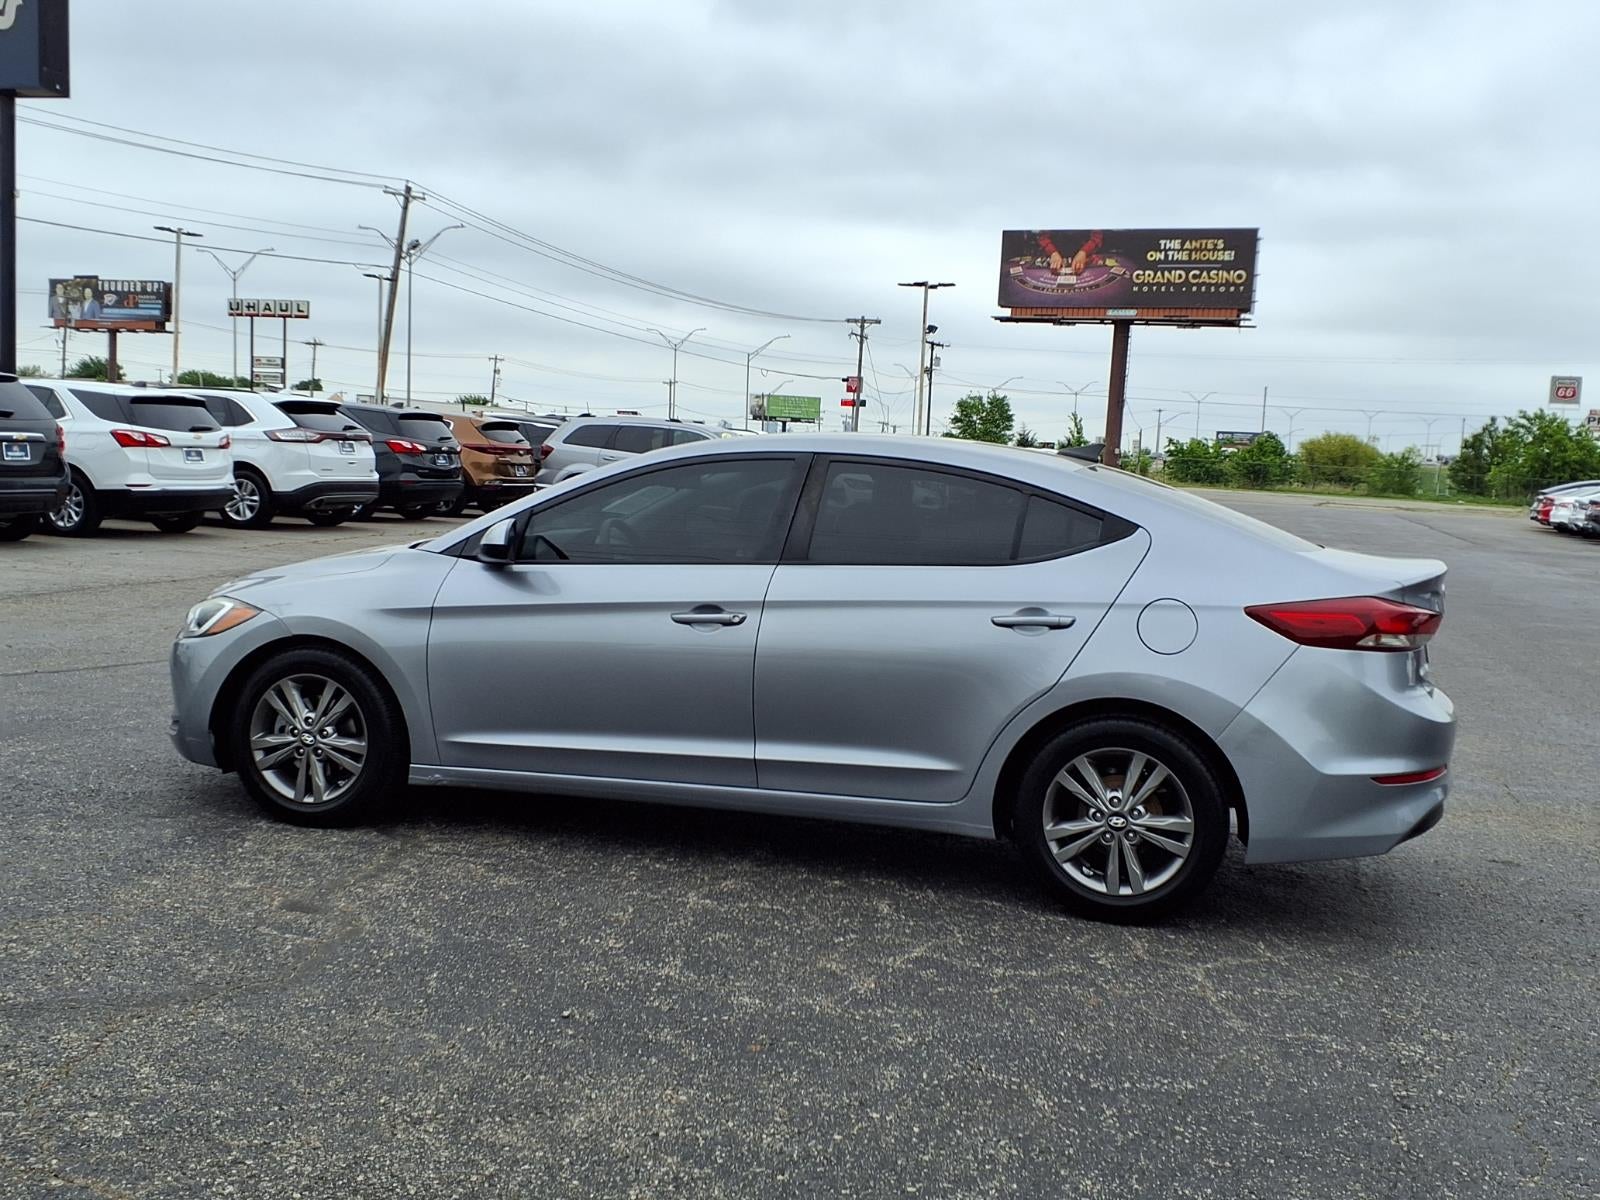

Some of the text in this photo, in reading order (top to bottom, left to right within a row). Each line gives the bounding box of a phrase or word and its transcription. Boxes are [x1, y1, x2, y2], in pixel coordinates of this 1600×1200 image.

[1159, 239, 1224, 249] THE ANTE'S
[1146, 250, 1235, 261] ON THE HOUSE!
[1132, 269, 1247, 284] GRAND CASINO
[97, 280, 142, 291] THUNDER
[1191, 285, 1244, 293] RESORT
[1557, 387, 1574, 397] 66
